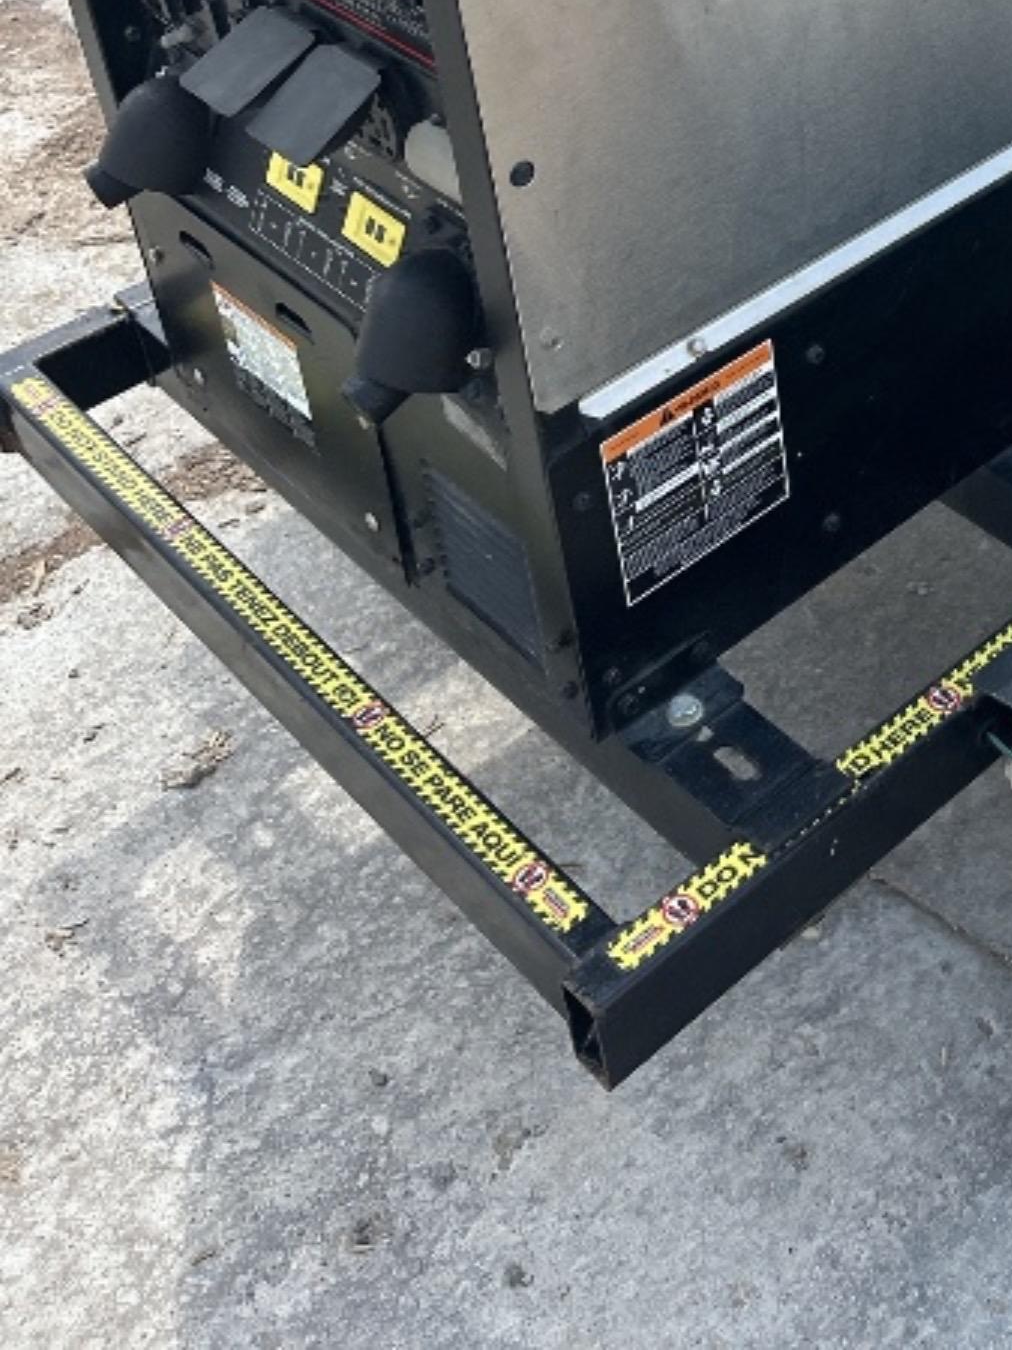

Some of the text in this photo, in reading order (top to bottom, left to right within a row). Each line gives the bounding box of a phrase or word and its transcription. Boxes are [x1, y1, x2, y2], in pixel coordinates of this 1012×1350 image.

[869, 707, 934, 760] HERE
[373, 723, 406, 752] NO
[399, 749, 430, 778] SE
[422, 773, 478, 823] PARE
[695, 865, 738, 899] DO
